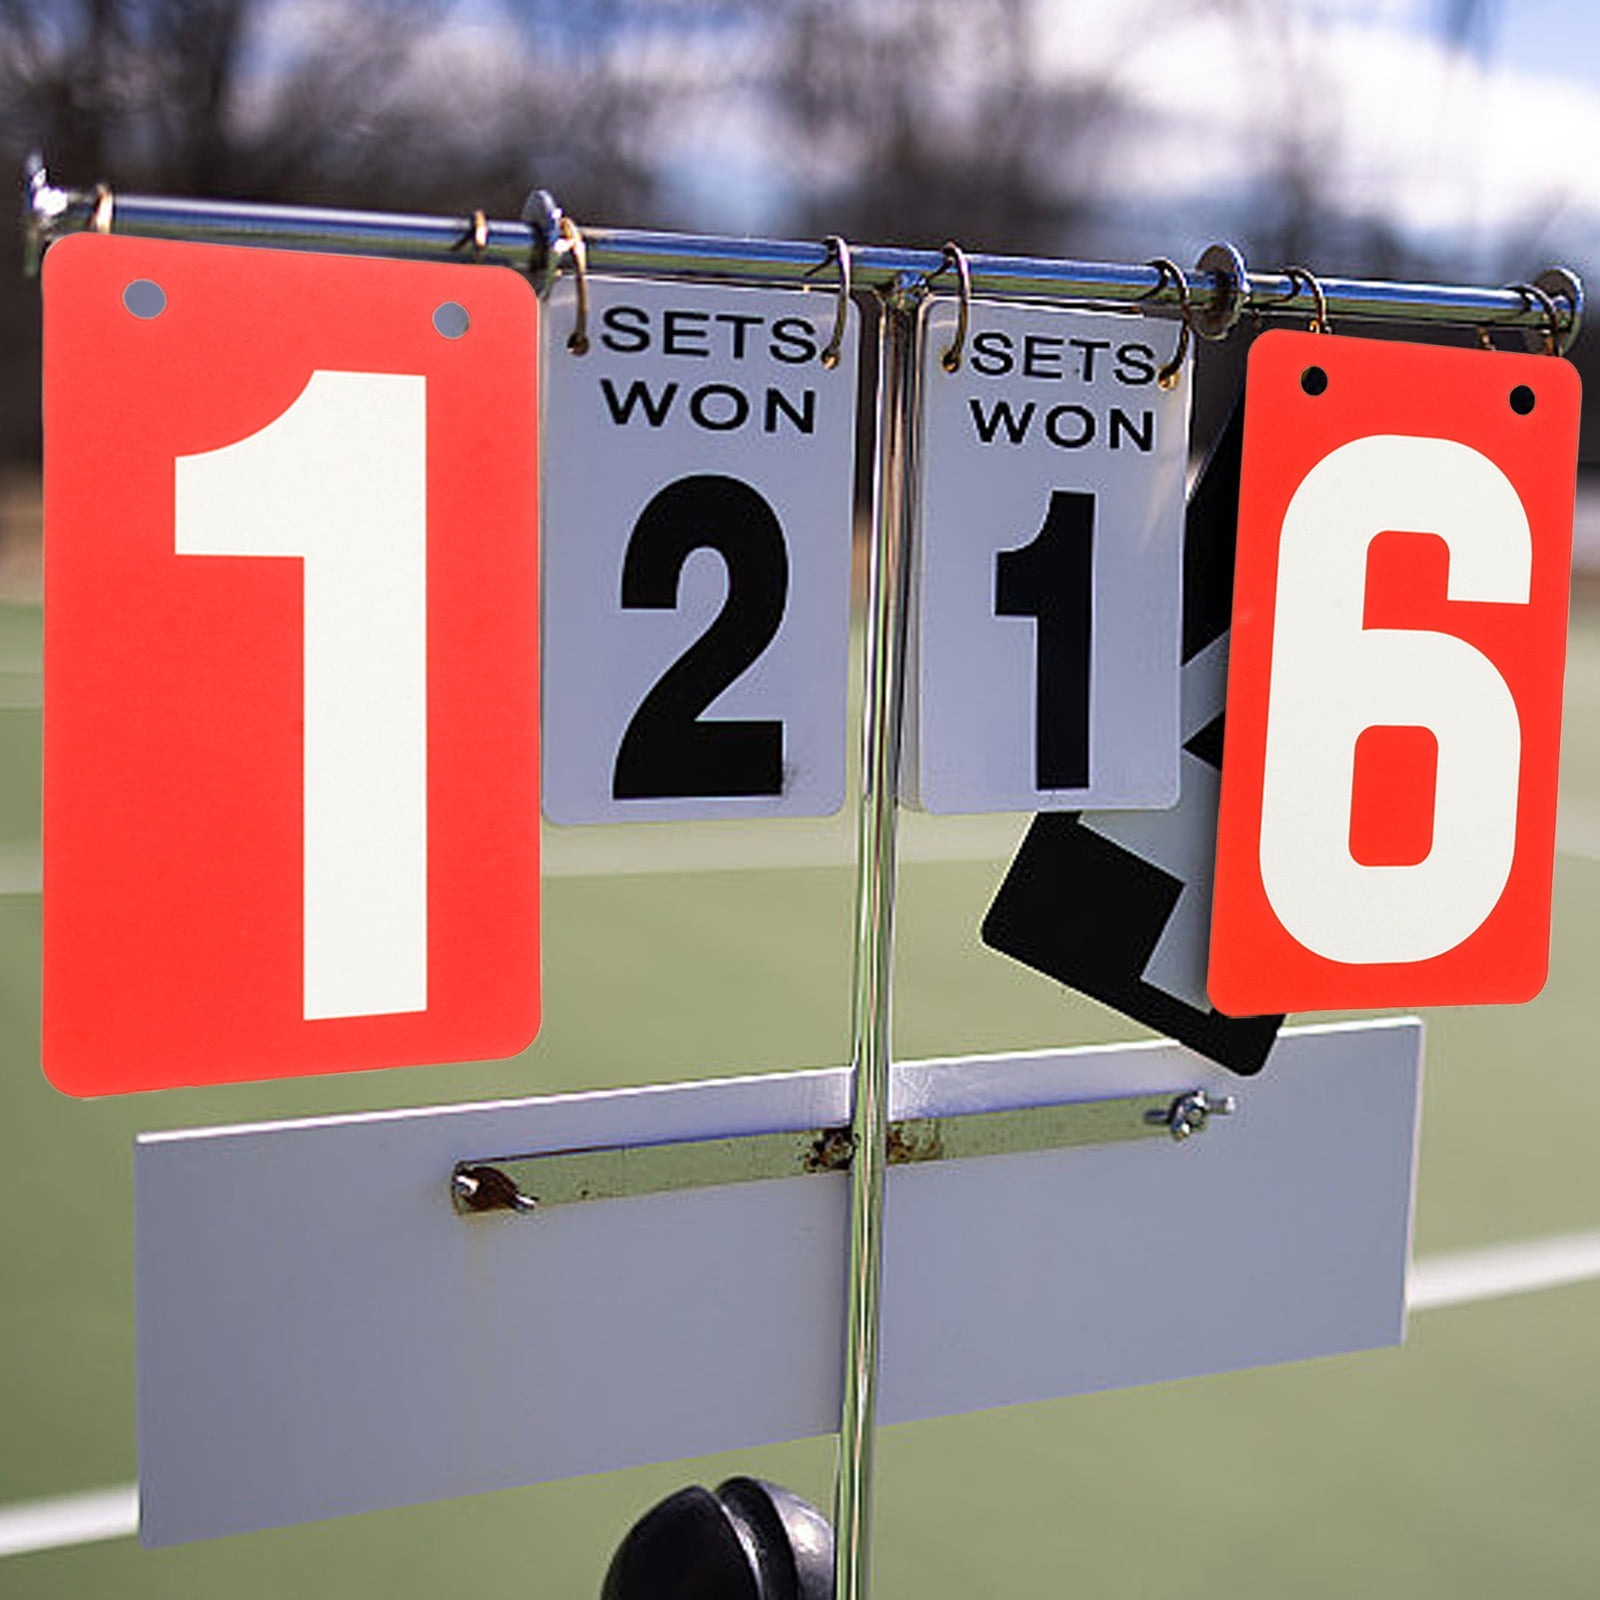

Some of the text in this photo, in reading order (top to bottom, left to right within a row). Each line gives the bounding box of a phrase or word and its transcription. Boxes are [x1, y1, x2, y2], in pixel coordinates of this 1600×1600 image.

[601, 306, 817, 364] SETS
[601, 379, 815, 434] WON
[970, 332, 1156, 385] SETS
[970, 399, 1153, 452] WON
[175, 370, 427, 1020] 1
[613, 474, 789, 800] 2
[994, 490, 1096, 791] 1
[1259, 434, 1532, 964] 6
